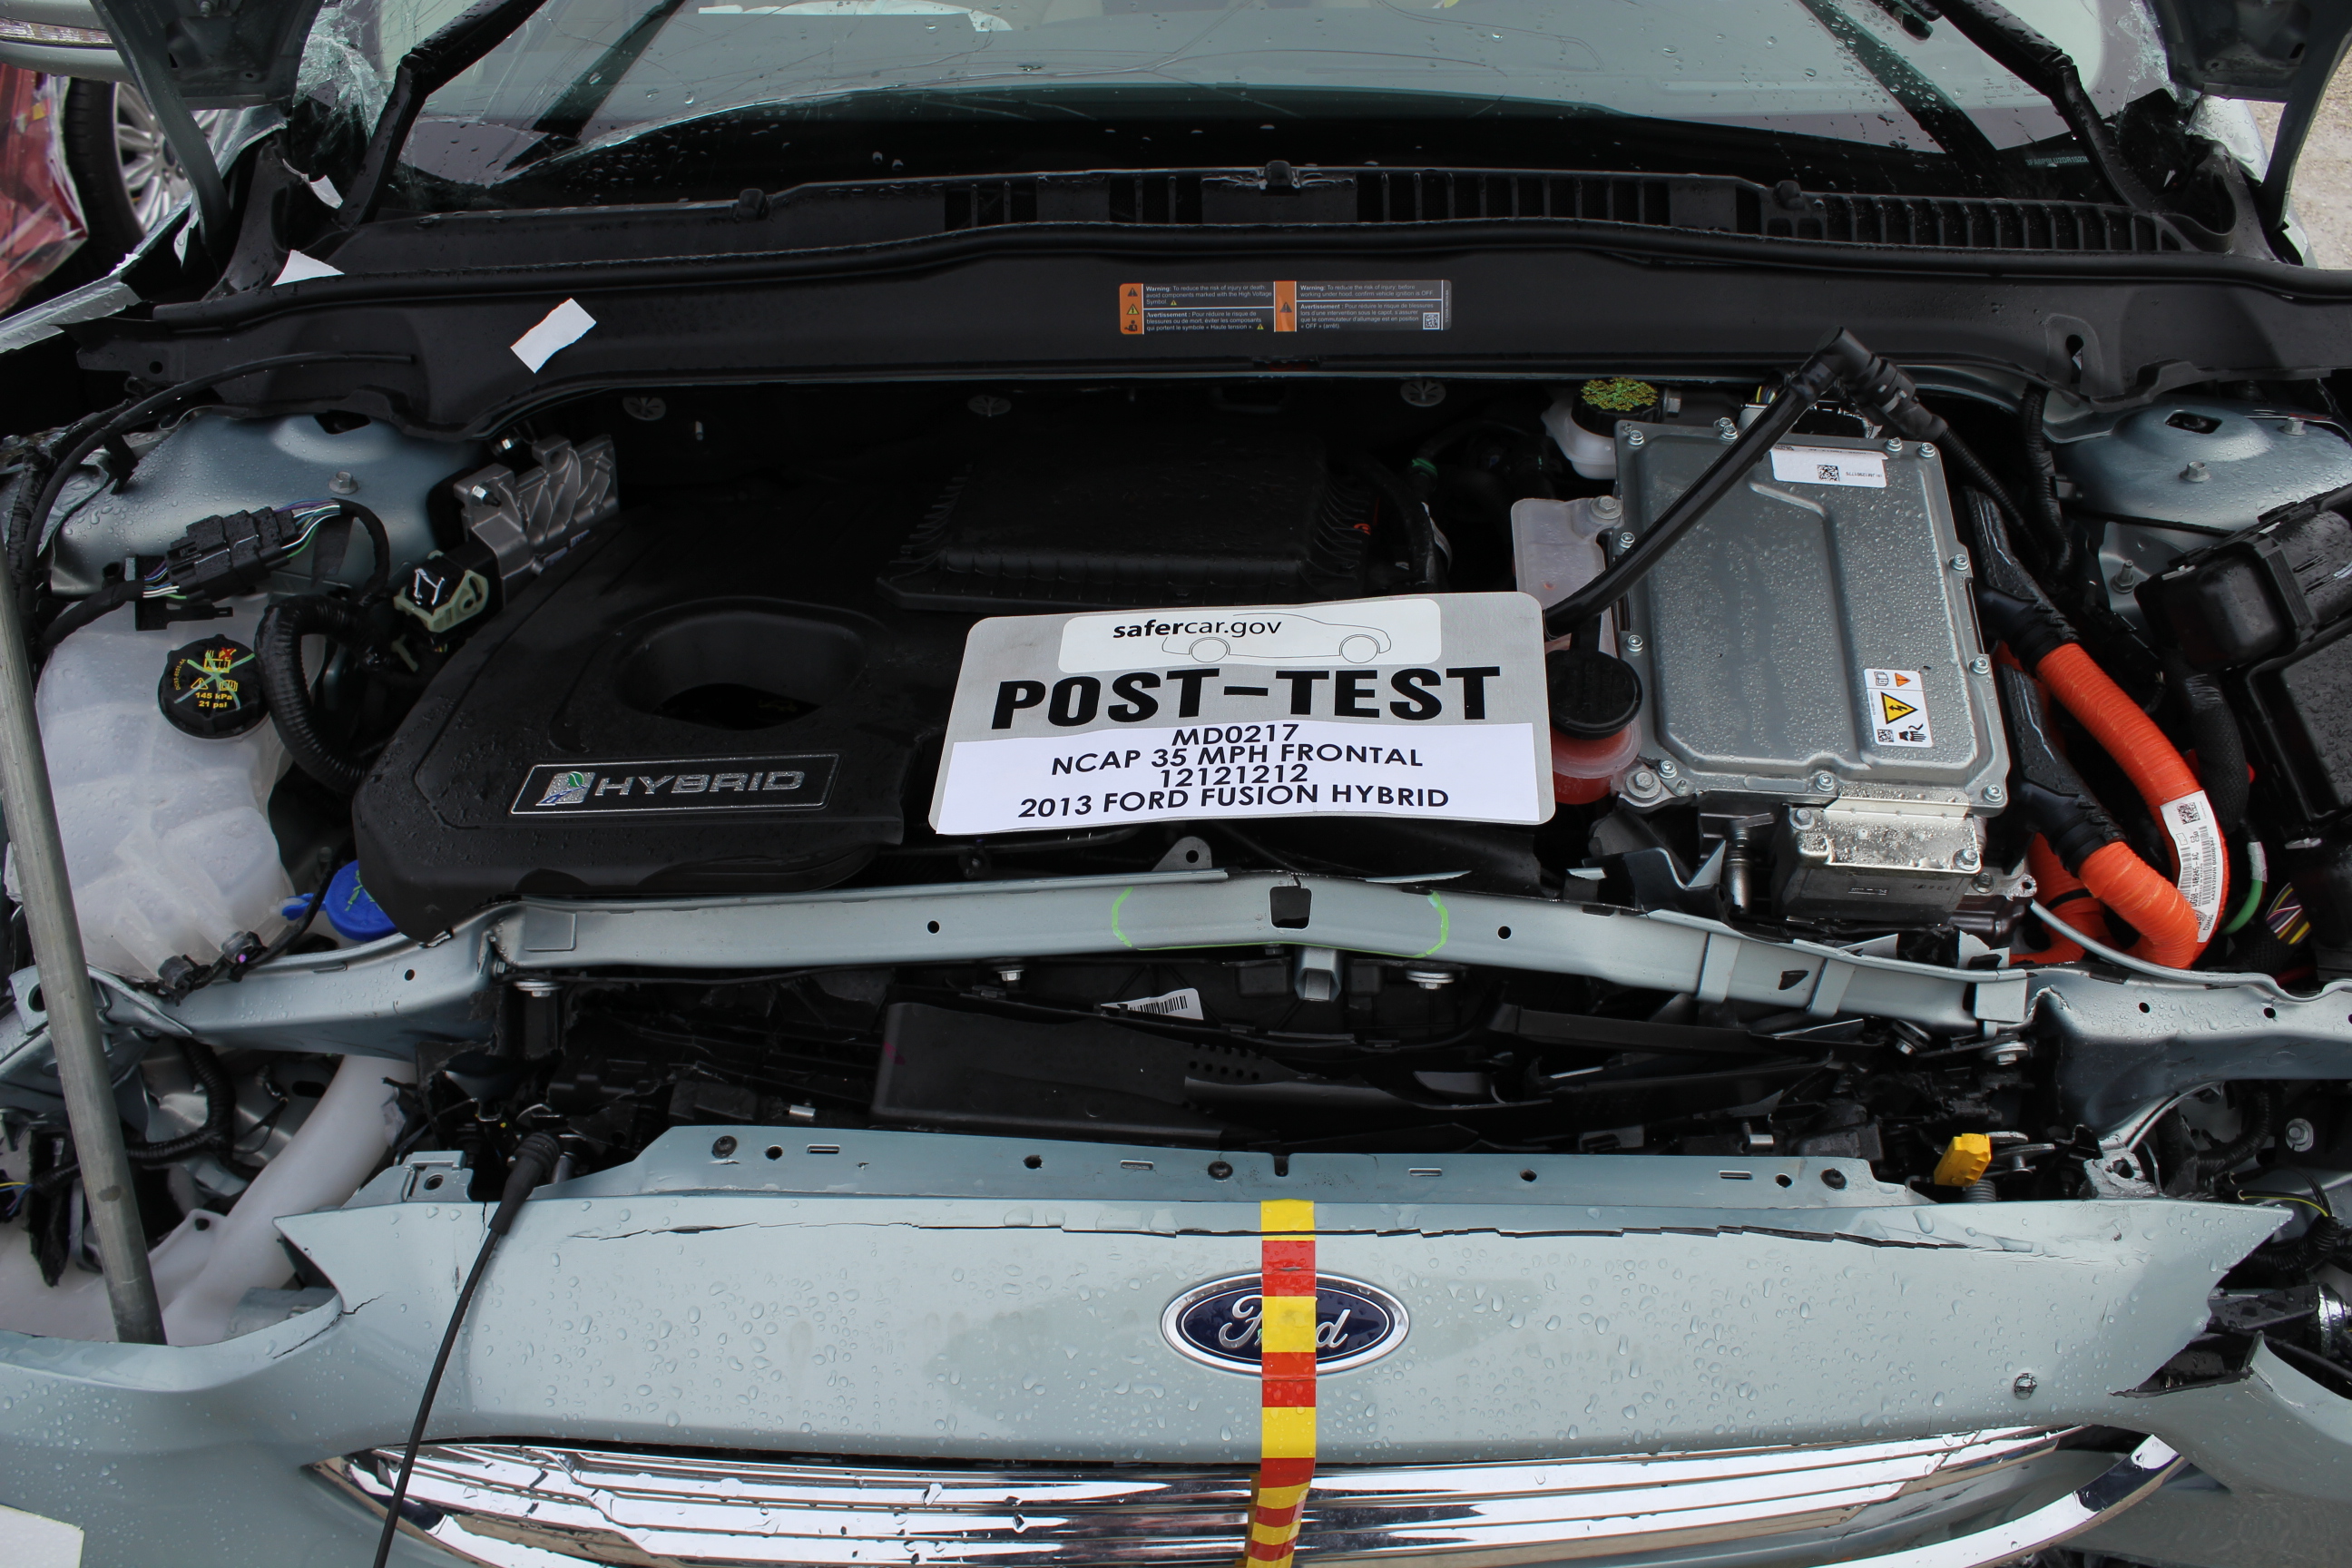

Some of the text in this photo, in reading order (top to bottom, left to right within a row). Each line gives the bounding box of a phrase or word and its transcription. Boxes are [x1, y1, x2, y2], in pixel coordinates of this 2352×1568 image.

[1112, 617, 1282, 641] safercar.gov
[992, 667, 1501, 729] POST-TEST
[1171, 724, 1299, 748] MD0217
[1050, 744, 1424, 776] NCAP 35 MPH FRONTAL
[594, 770, 806, 797] HYBRID
[1159, 764, 1308, 788] 12121212
[1019, 783, 1449, 818] 2013 FORD FUSION HYBRID
[1218, 1294, 1351, 1349] Fd
